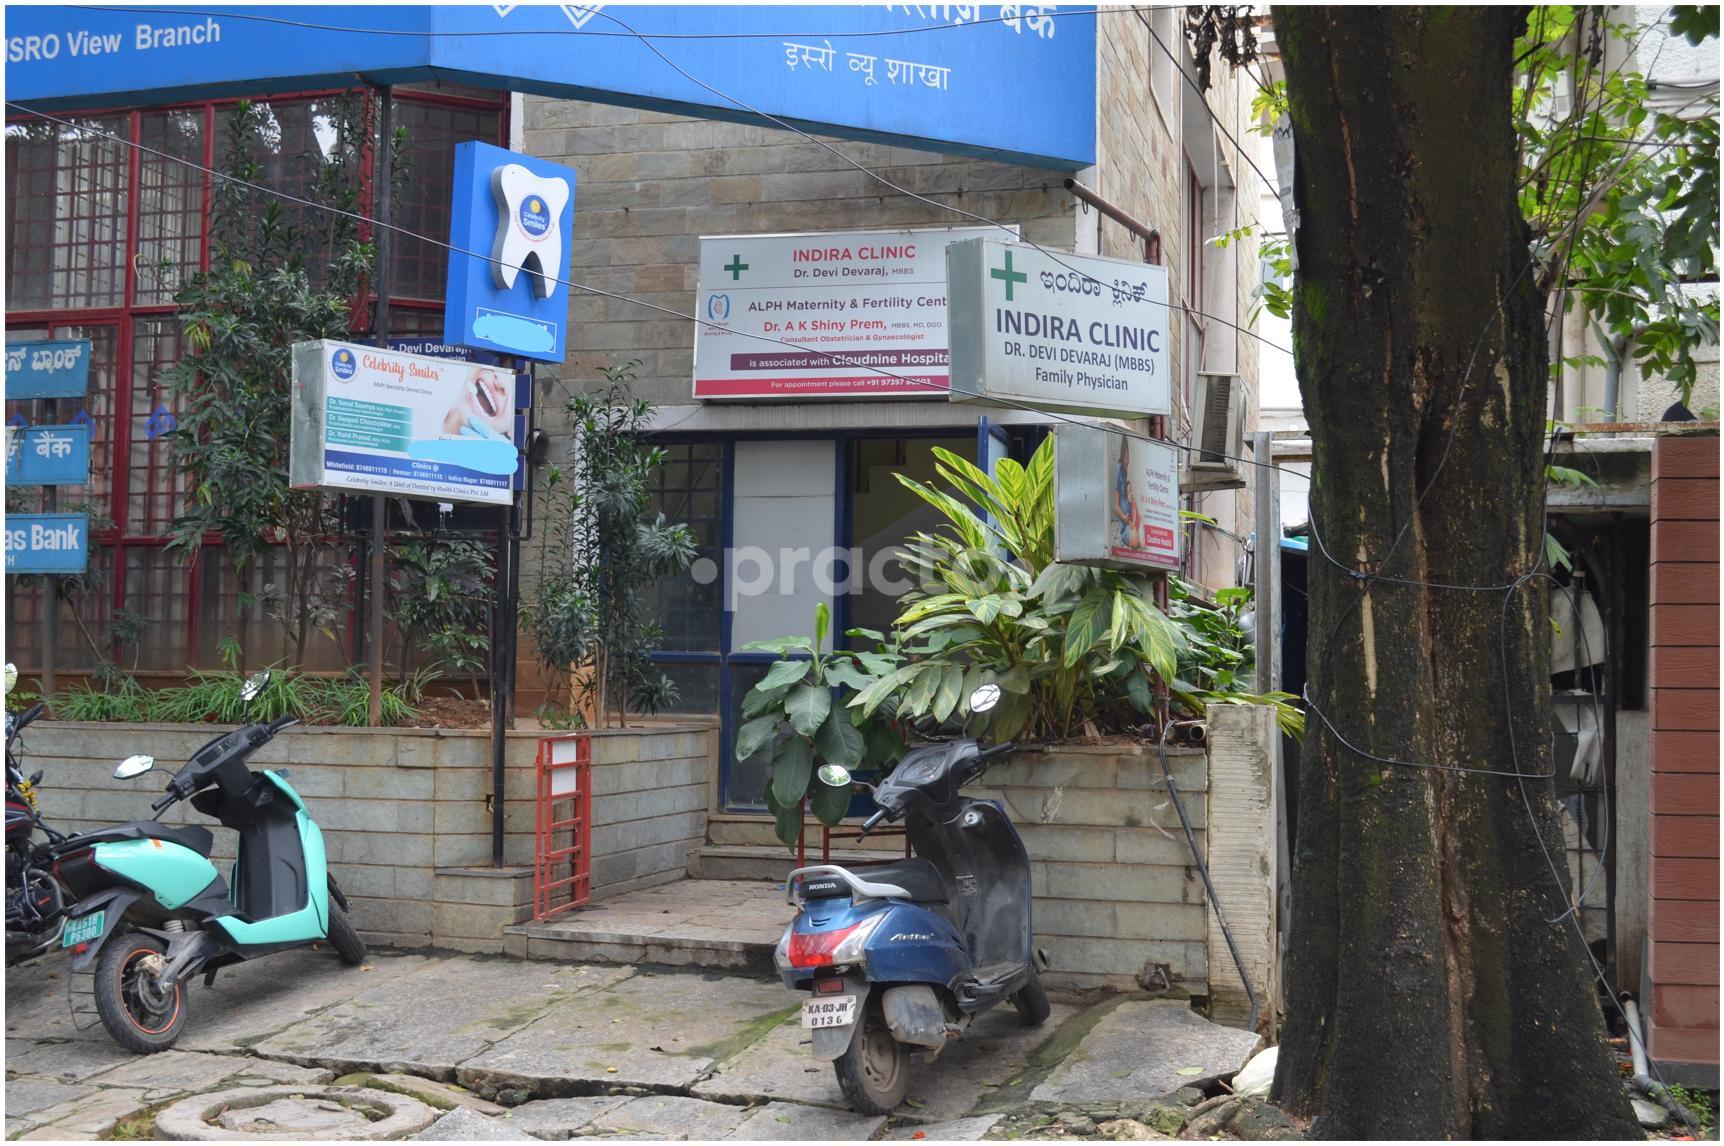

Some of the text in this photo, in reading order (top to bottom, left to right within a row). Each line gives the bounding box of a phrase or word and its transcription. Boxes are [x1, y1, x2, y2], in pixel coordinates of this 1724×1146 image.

[67, 31, 122, 57] View
[135, 18, 221, 50] Branch
[783, 40, 952, 91] इस्रो व्यू शाखा
[793, 245, 916, 262] INDIRA CLINIC
[794, 265, 914, 278] Dr. Devi Devaraj, MBBS
[1040, 271, 1148, 309] ಇಂದಿರಾ ಕ್ಲಿನಿಕ್
[748, 301, 783, 312] ALPH
[786, 298, 847, 311] Maternity
[849, 298, 859, 309] &
[862, 297, 913, 310] Fertility
[764, 321, 781, 332] Dr.
[784, 321, 795, 331] A
[798, 320, 808, 331] K
[811, 318, 847, 332] Shiny
[850, 319, 887, 331] Prem,
[996, 308, 1161, 353] INDIRA CLINIC
[781, 336, 819, 344] Consultant
[820, 334, 864, 343] Obstetrician
[872, 333, 925, 342] Gynaecologist
[399, 343, 423, 354] Devi
[749, 359, 758, 368] is
[759, 357, 808, 367] associated
[810, 356, 830, 367] with
[832, 353, 898, 366] Cloudnine
[1004, 341, 1155, 376] DR. DEVI DEVARAJ (MBBS)
[363, 354, 440, 382] Celebrity Smiles
[771, 381, 784, 389] For
[784, 381, 828, 390] appointment
[829, 380, 851, 388] please
[852, 379, 865, 387] call
[881, 378, 905, 386] 97397
[1035, 367, 1129, 391] Family Physician
[328, 430, 337, 438] Dr.
[33, 430, 75, 458] बैंक
[411, 461, 432, 470] Clinics
[31, 523, 80, 551] Bank
[807, 1002, 848, 1015] KA-03-JH
